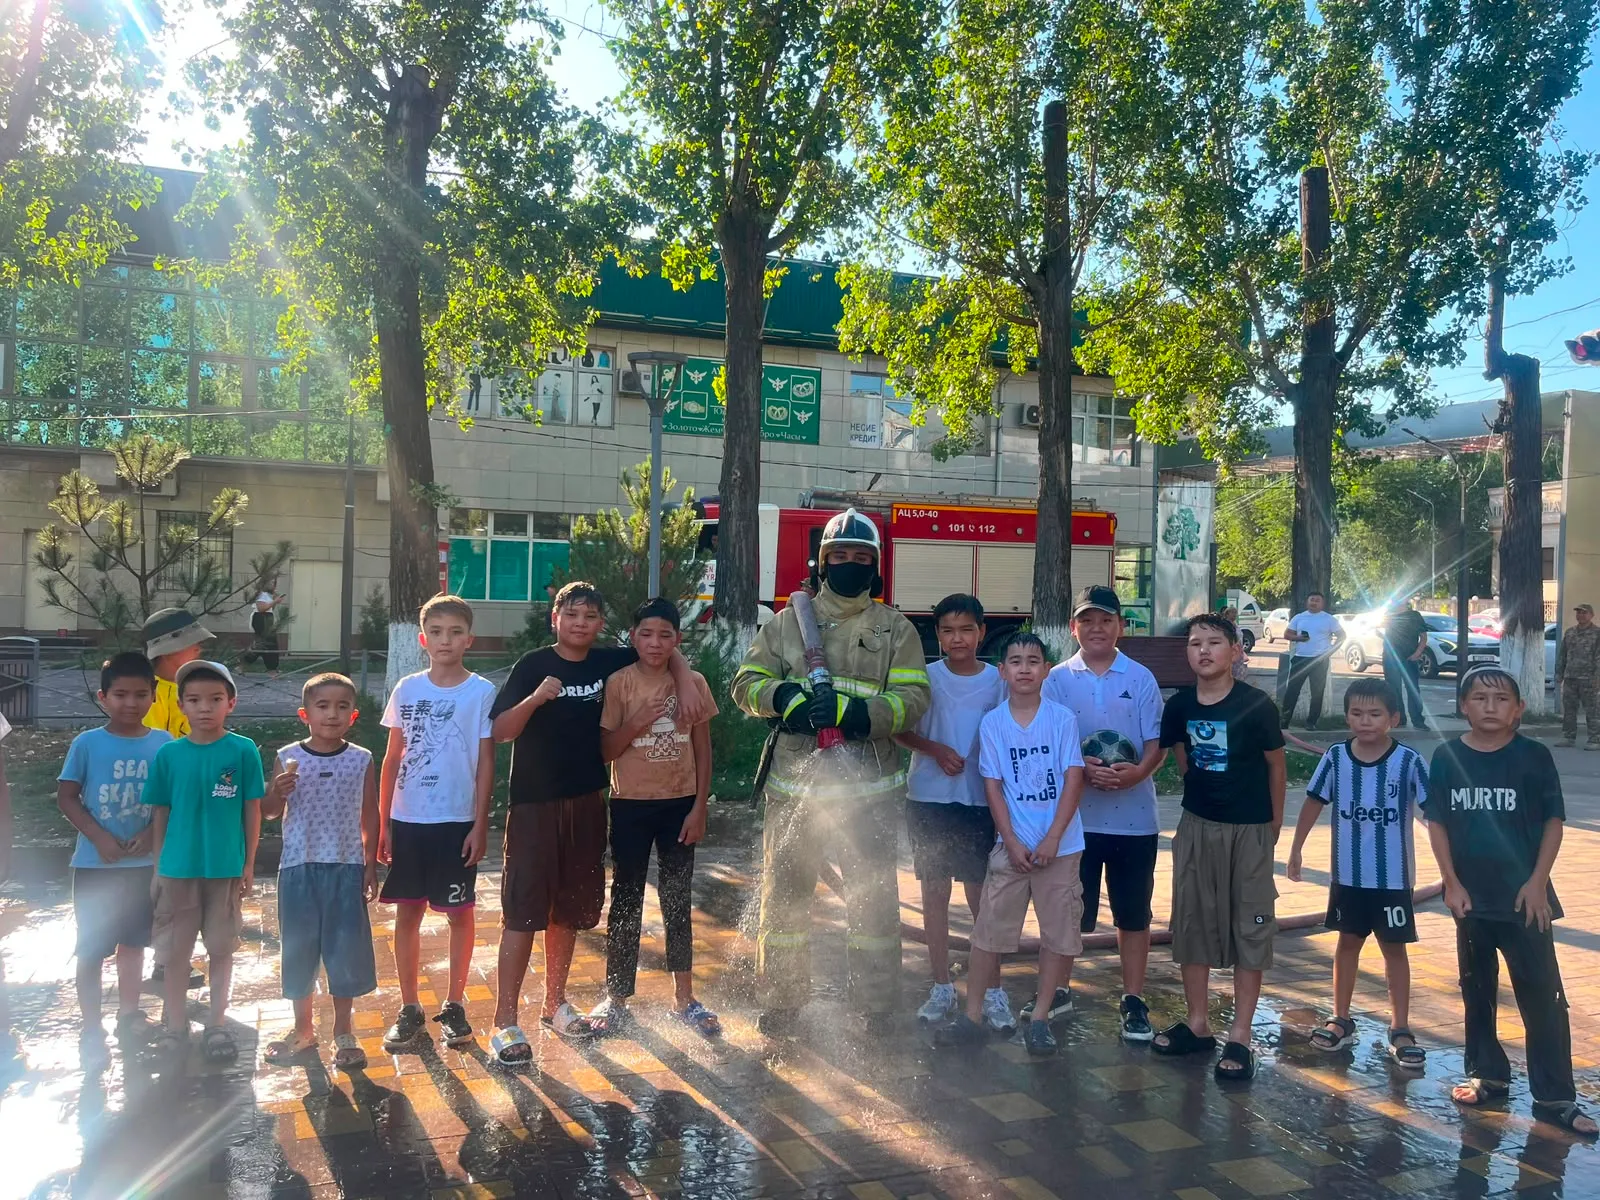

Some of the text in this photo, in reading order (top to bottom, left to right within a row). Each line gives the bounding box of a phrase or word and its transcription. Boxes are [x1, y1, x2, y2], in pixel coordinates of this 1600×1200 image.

[667, 422, 698, 432] Золото
[702, 425, 724, 434] Жем
[780, 431, 801, 440] Часы
[850, 423, 877, 433] НЕСИЕ
[850, 433, 877, 443] КРЕДИТ
[898, 508, 938, 518] АЦ 5,0-40
[948, 523, 996, 533] 101 112
[113, 759, 149, 779] SEA
[1450, 787, 1517, 811] MURTB
[1340, 801, 1399, 826] Jeep
[1384, 905, 1406, 928] 10
